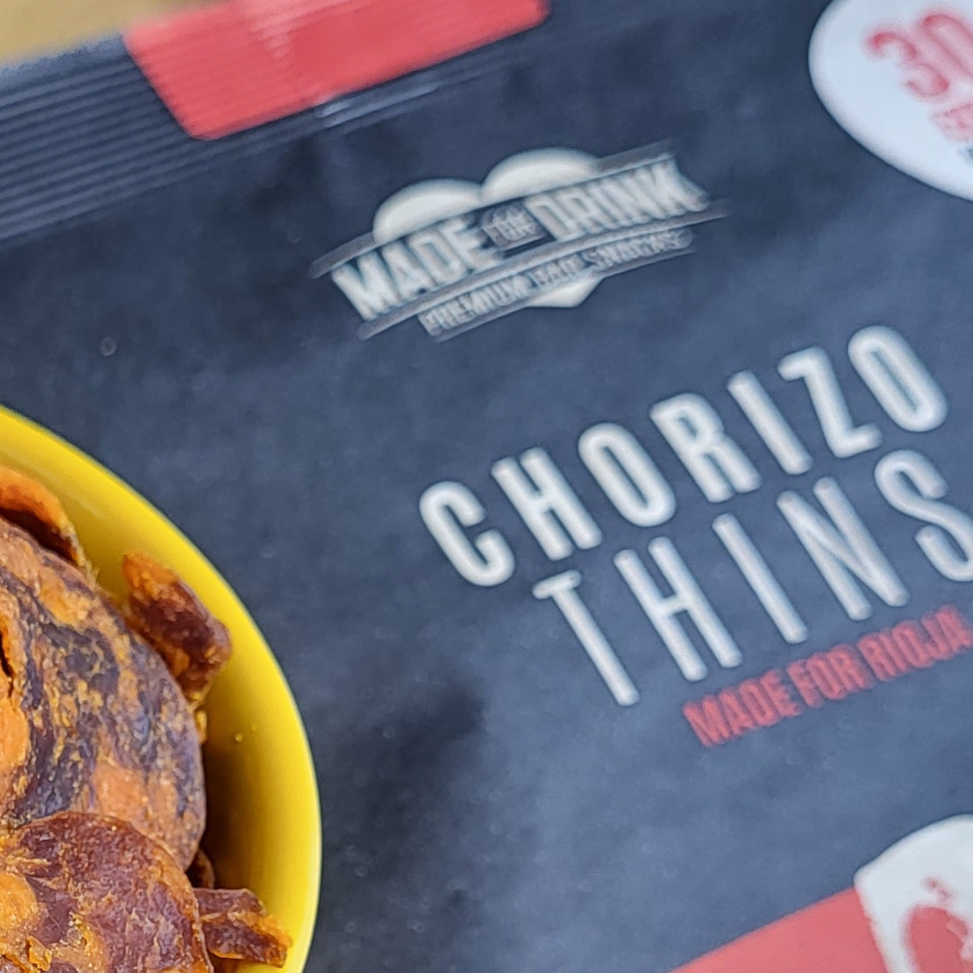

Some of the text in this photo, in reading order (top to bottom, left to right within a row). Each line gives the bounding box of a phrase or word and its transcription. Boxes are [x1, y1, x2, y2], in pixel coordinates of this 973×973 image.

[331, 214, 504, 320] MADE
[526, 152, 710, 242] DRINK
[420, 274, 533, 336] PREMIUM
[583, 230, 691, 271] SNACKS
[419, 325, 948, 586] CHORIZO
[531, 449, 973, 706] THINS
[682, 604, 973, 748] MADE FOR RIOJA
